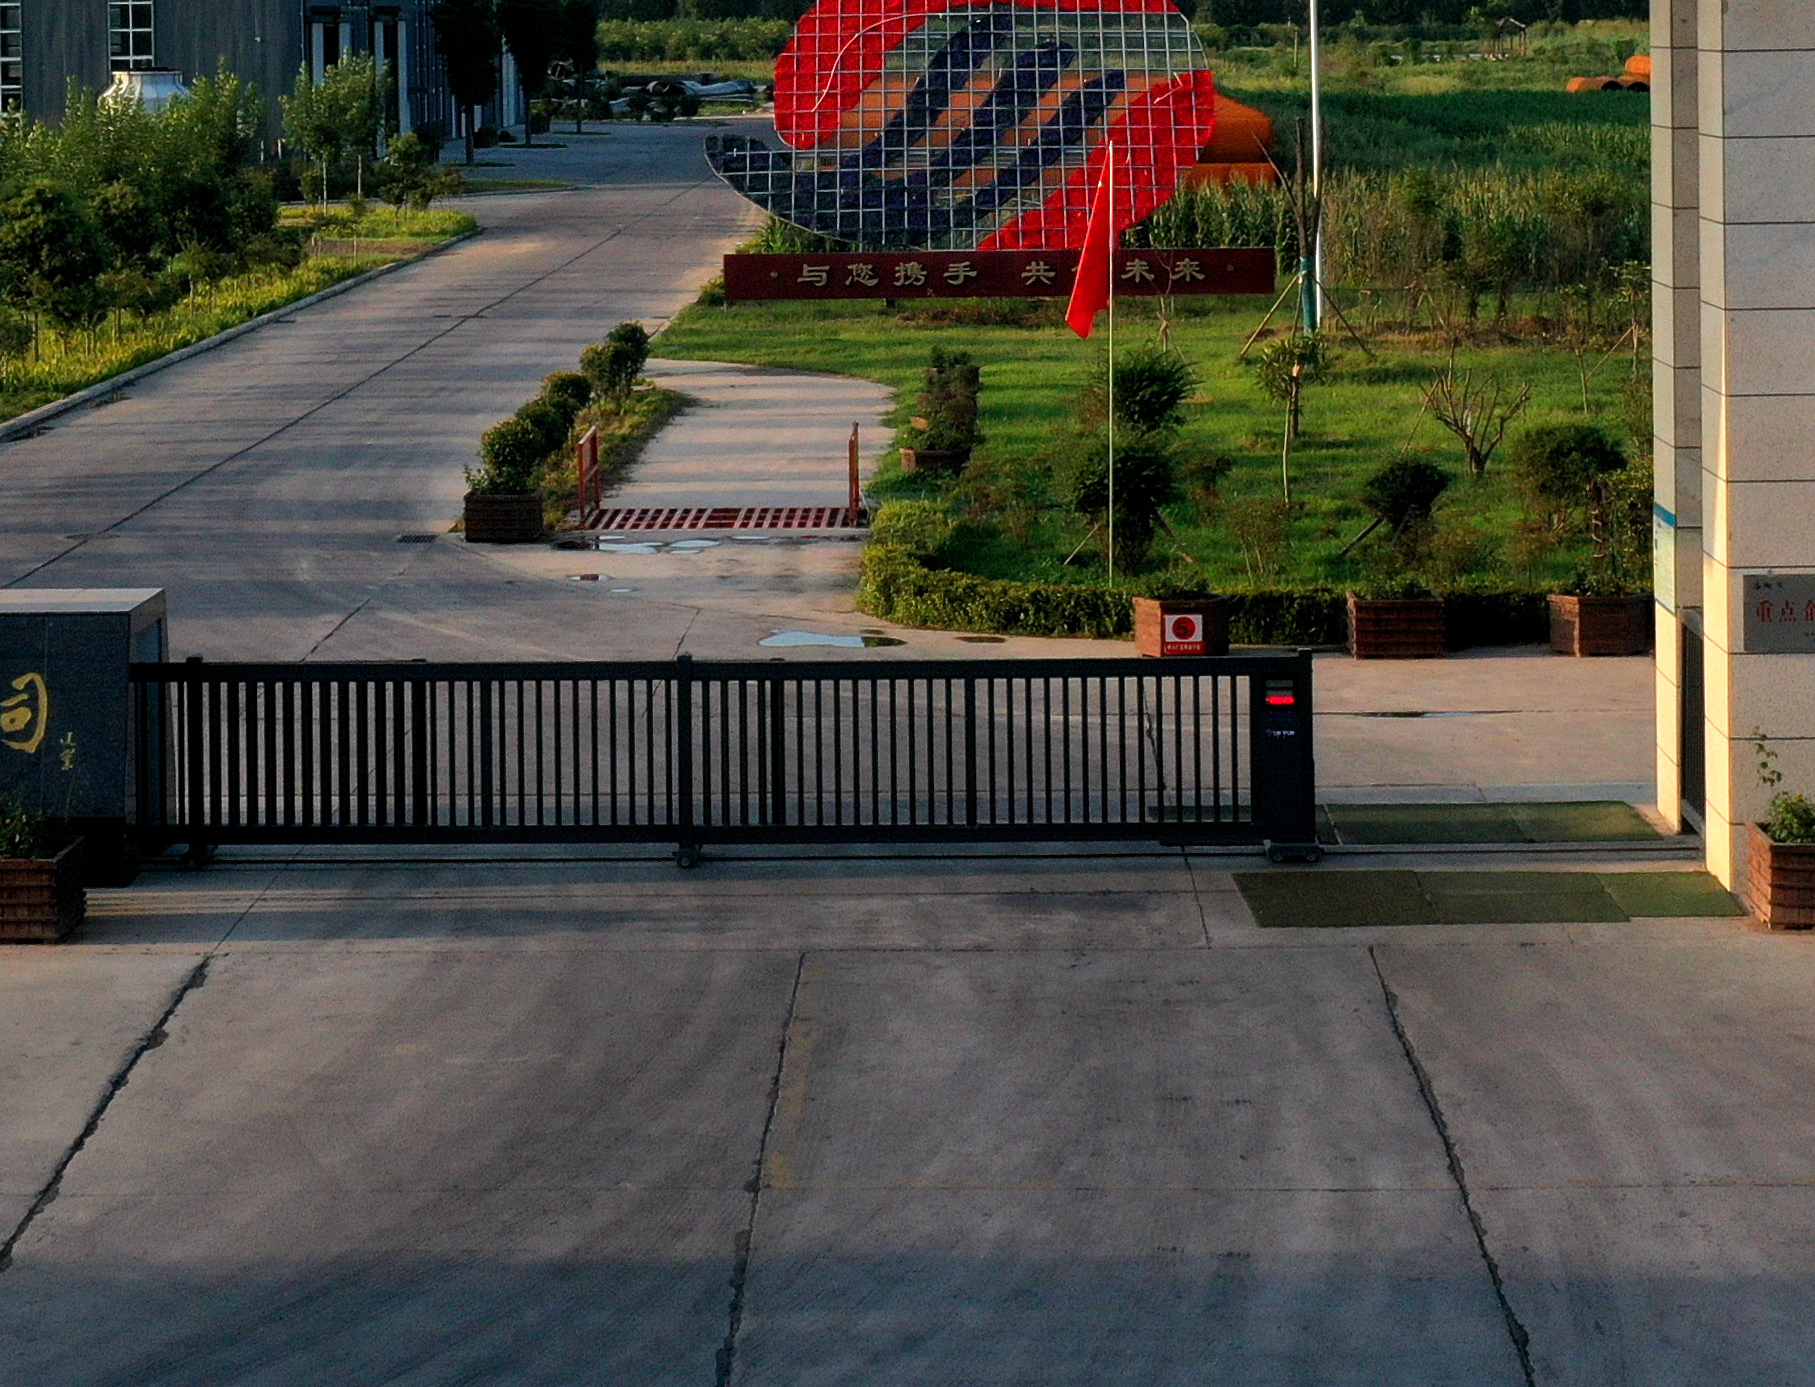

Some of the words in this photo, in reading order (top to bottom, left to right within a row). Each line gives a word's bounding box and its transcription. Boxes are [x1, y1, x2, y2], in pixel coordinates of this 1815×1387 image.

[796, 262, 978, 287] 与您携手
[1020, 258, 1205, 286] 共未来
